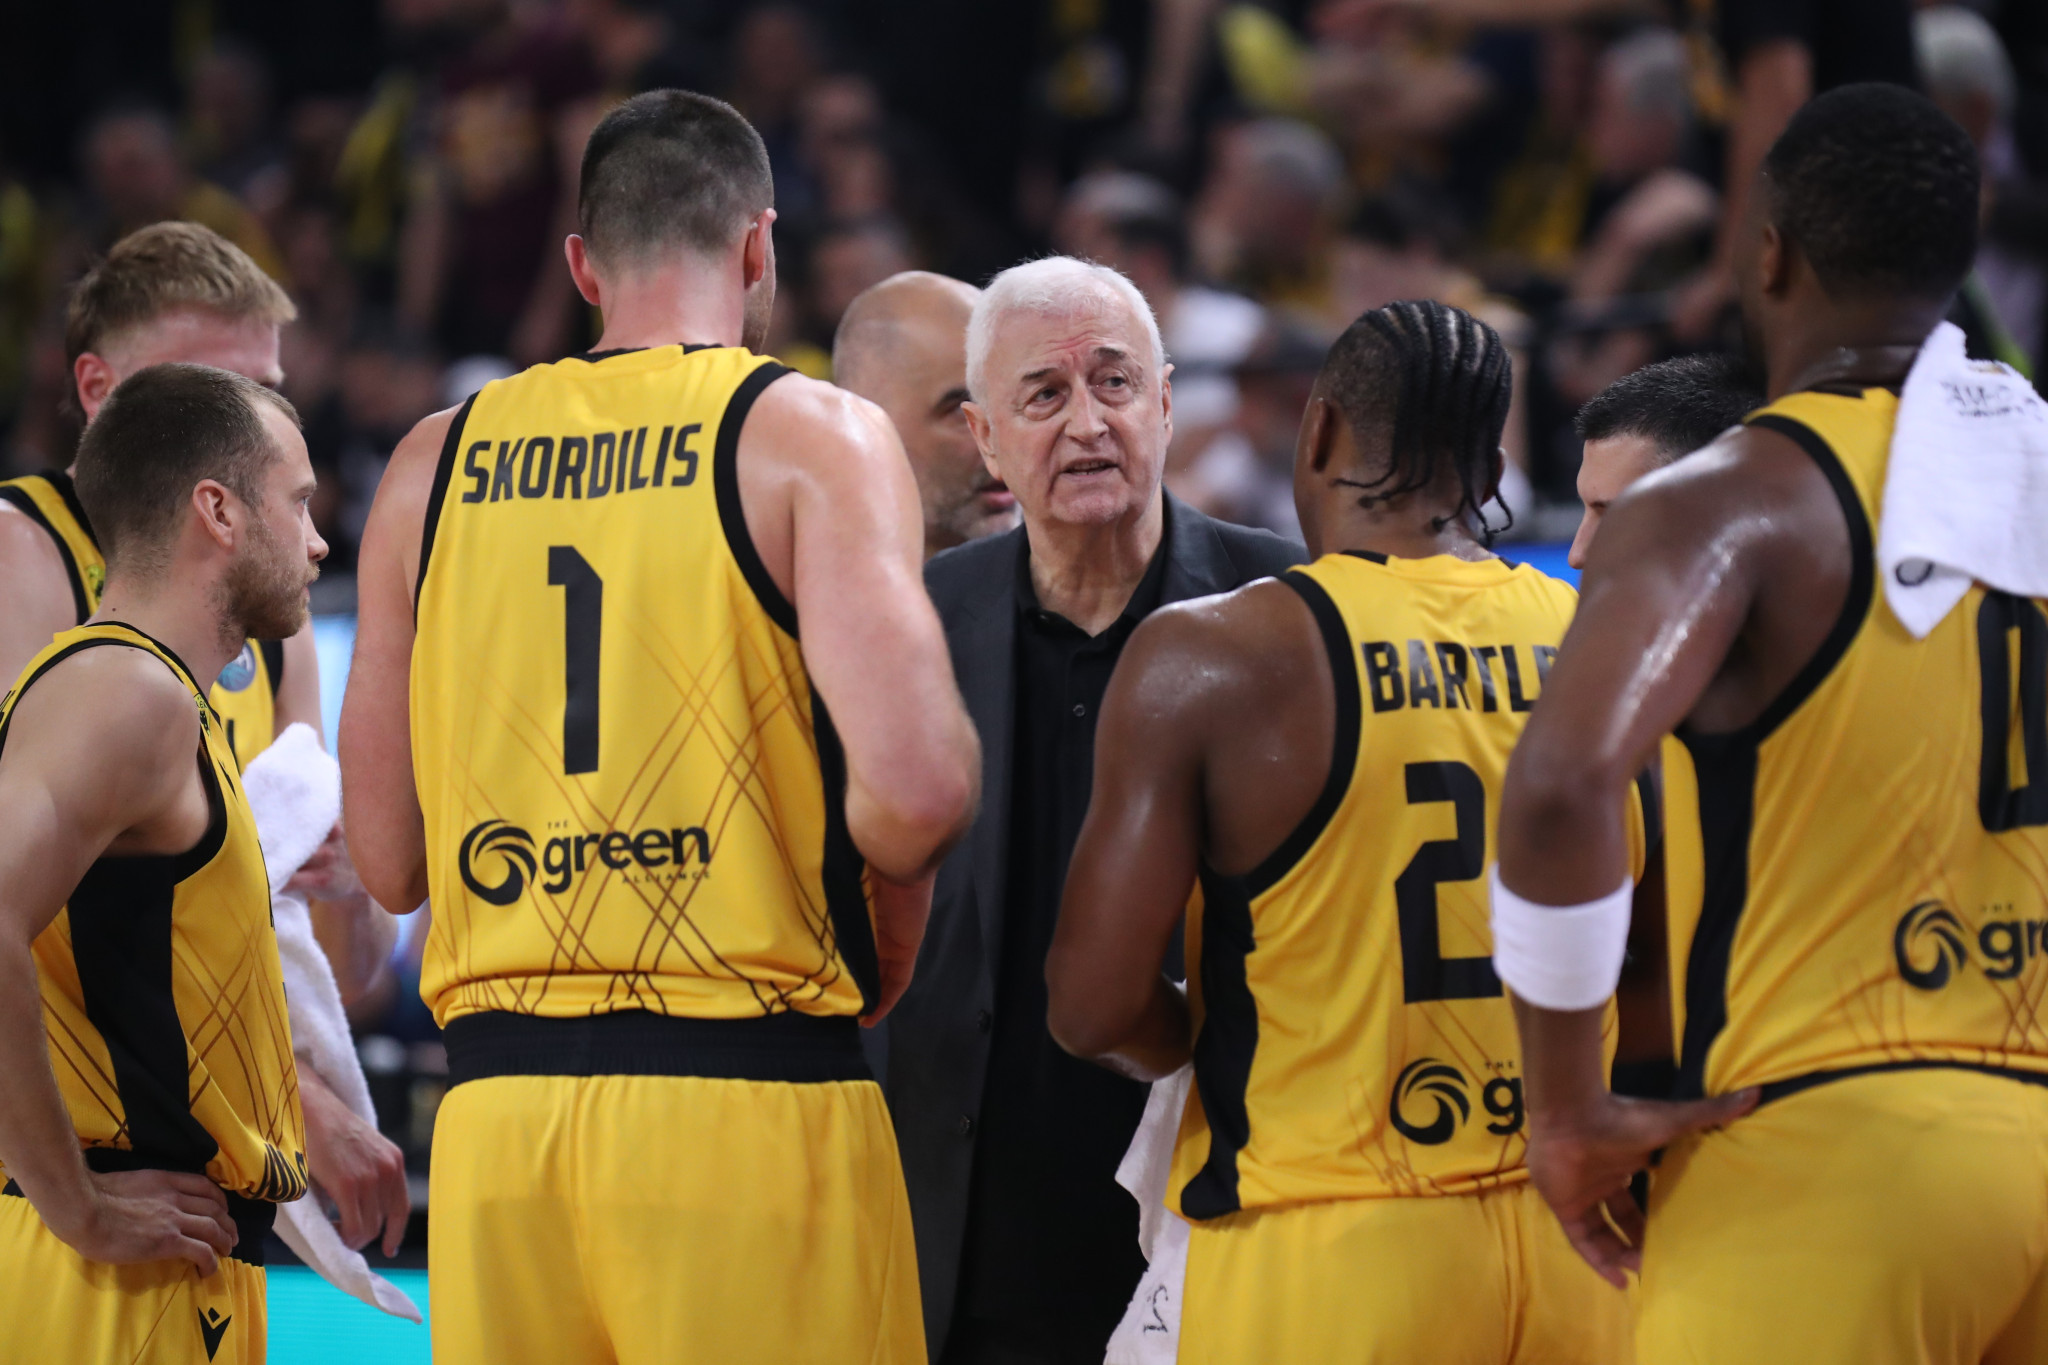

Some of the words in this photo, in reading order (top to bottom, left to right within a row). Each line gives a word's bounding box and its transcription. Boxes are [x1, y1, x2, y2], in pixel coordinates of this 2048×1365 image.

[462, 422, 703, 504] SKORDILIS
[547, 545, 603, 776] 1
[543, 826, 712, 895] green
[1394, 760, 1505, 1005] 2
[1978, 920, 2048, 981] gr
